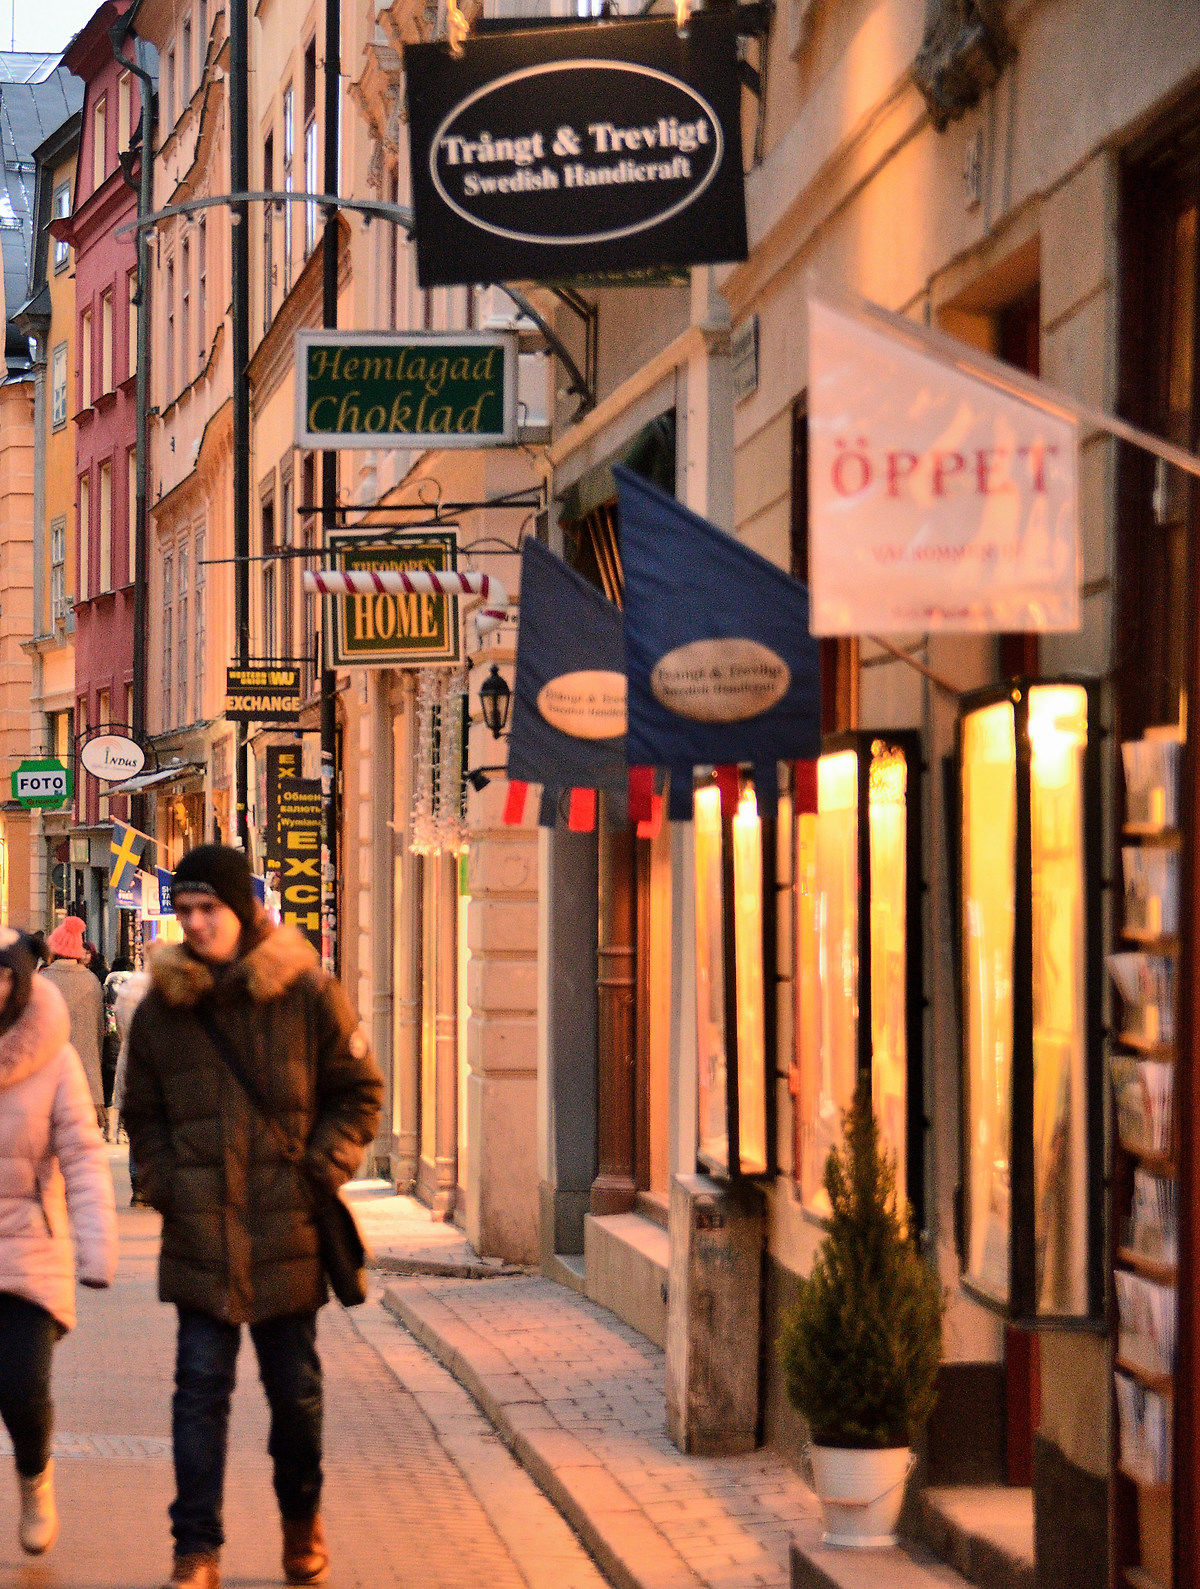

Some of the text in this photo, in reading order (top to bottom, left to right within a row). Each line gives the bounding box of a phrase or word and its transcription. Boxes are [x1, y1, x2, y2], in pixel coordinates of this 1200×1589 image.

[441, 117, 710, 166] Trångt & Trevligt
[464, 155, 692, 197] Swedish Handicraft
[307, 346, 498, 397] Hemlagad
[308, 389, 496, 433] Choklad
[830, 436, 1060, 497] ÖPPET
[353, 593, 439, 640] HOME
[226, 695, 300, 711] EXCHANGE
[20, 777, 63, 790] FOTO
